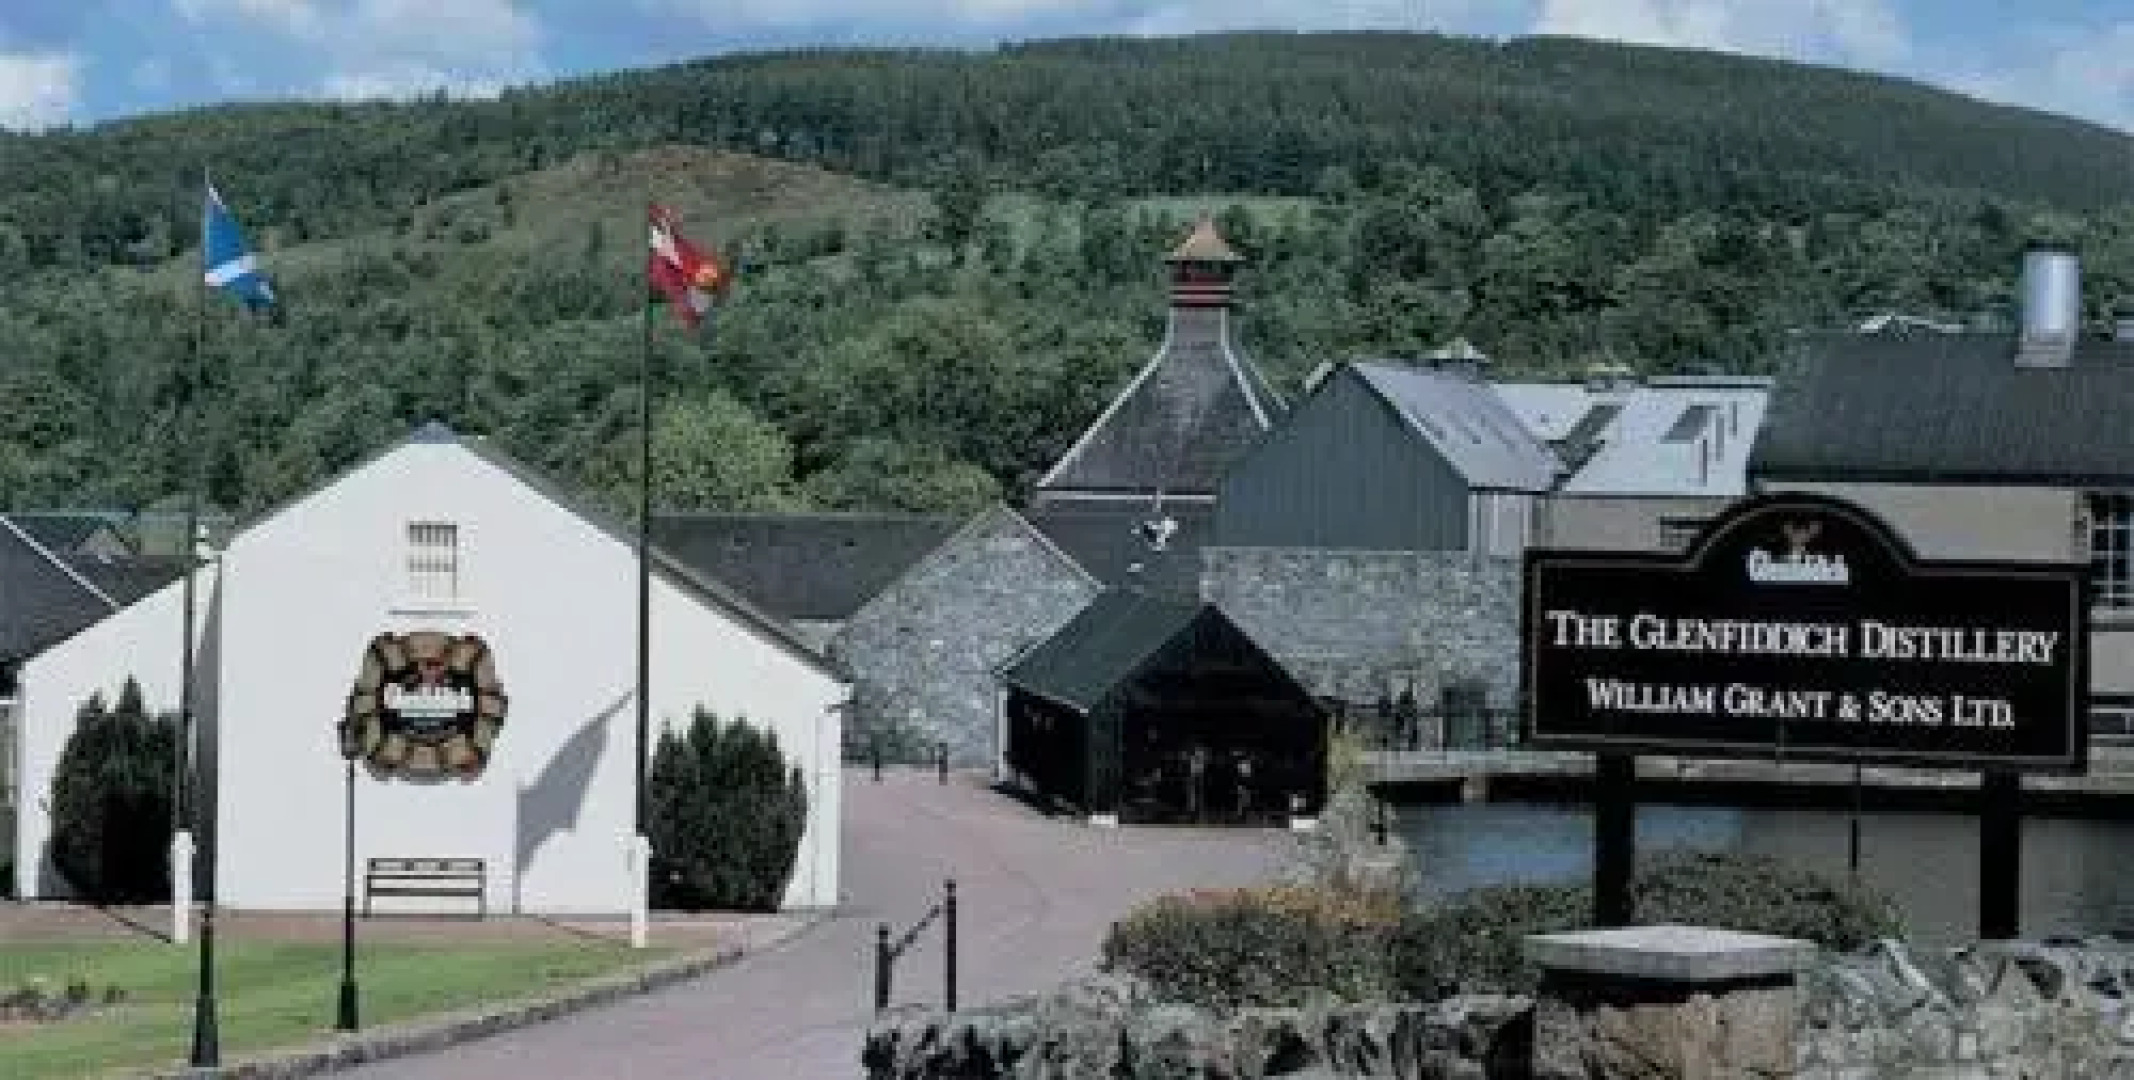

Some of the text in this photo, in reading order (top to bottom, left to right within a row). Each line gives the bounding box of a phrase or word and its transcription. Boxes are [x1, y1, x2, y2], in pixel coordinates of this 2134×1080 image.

[1546, 610, 2058, 665] THE GLENFIDDICH DISTILLERY
[1587, 678, 1714, 715] WILLIAM
[1723, 683, 1832, 719] GRANT
[1838, 692, 1861, 721] &
[1867, 691, 1943, 726] SONS
